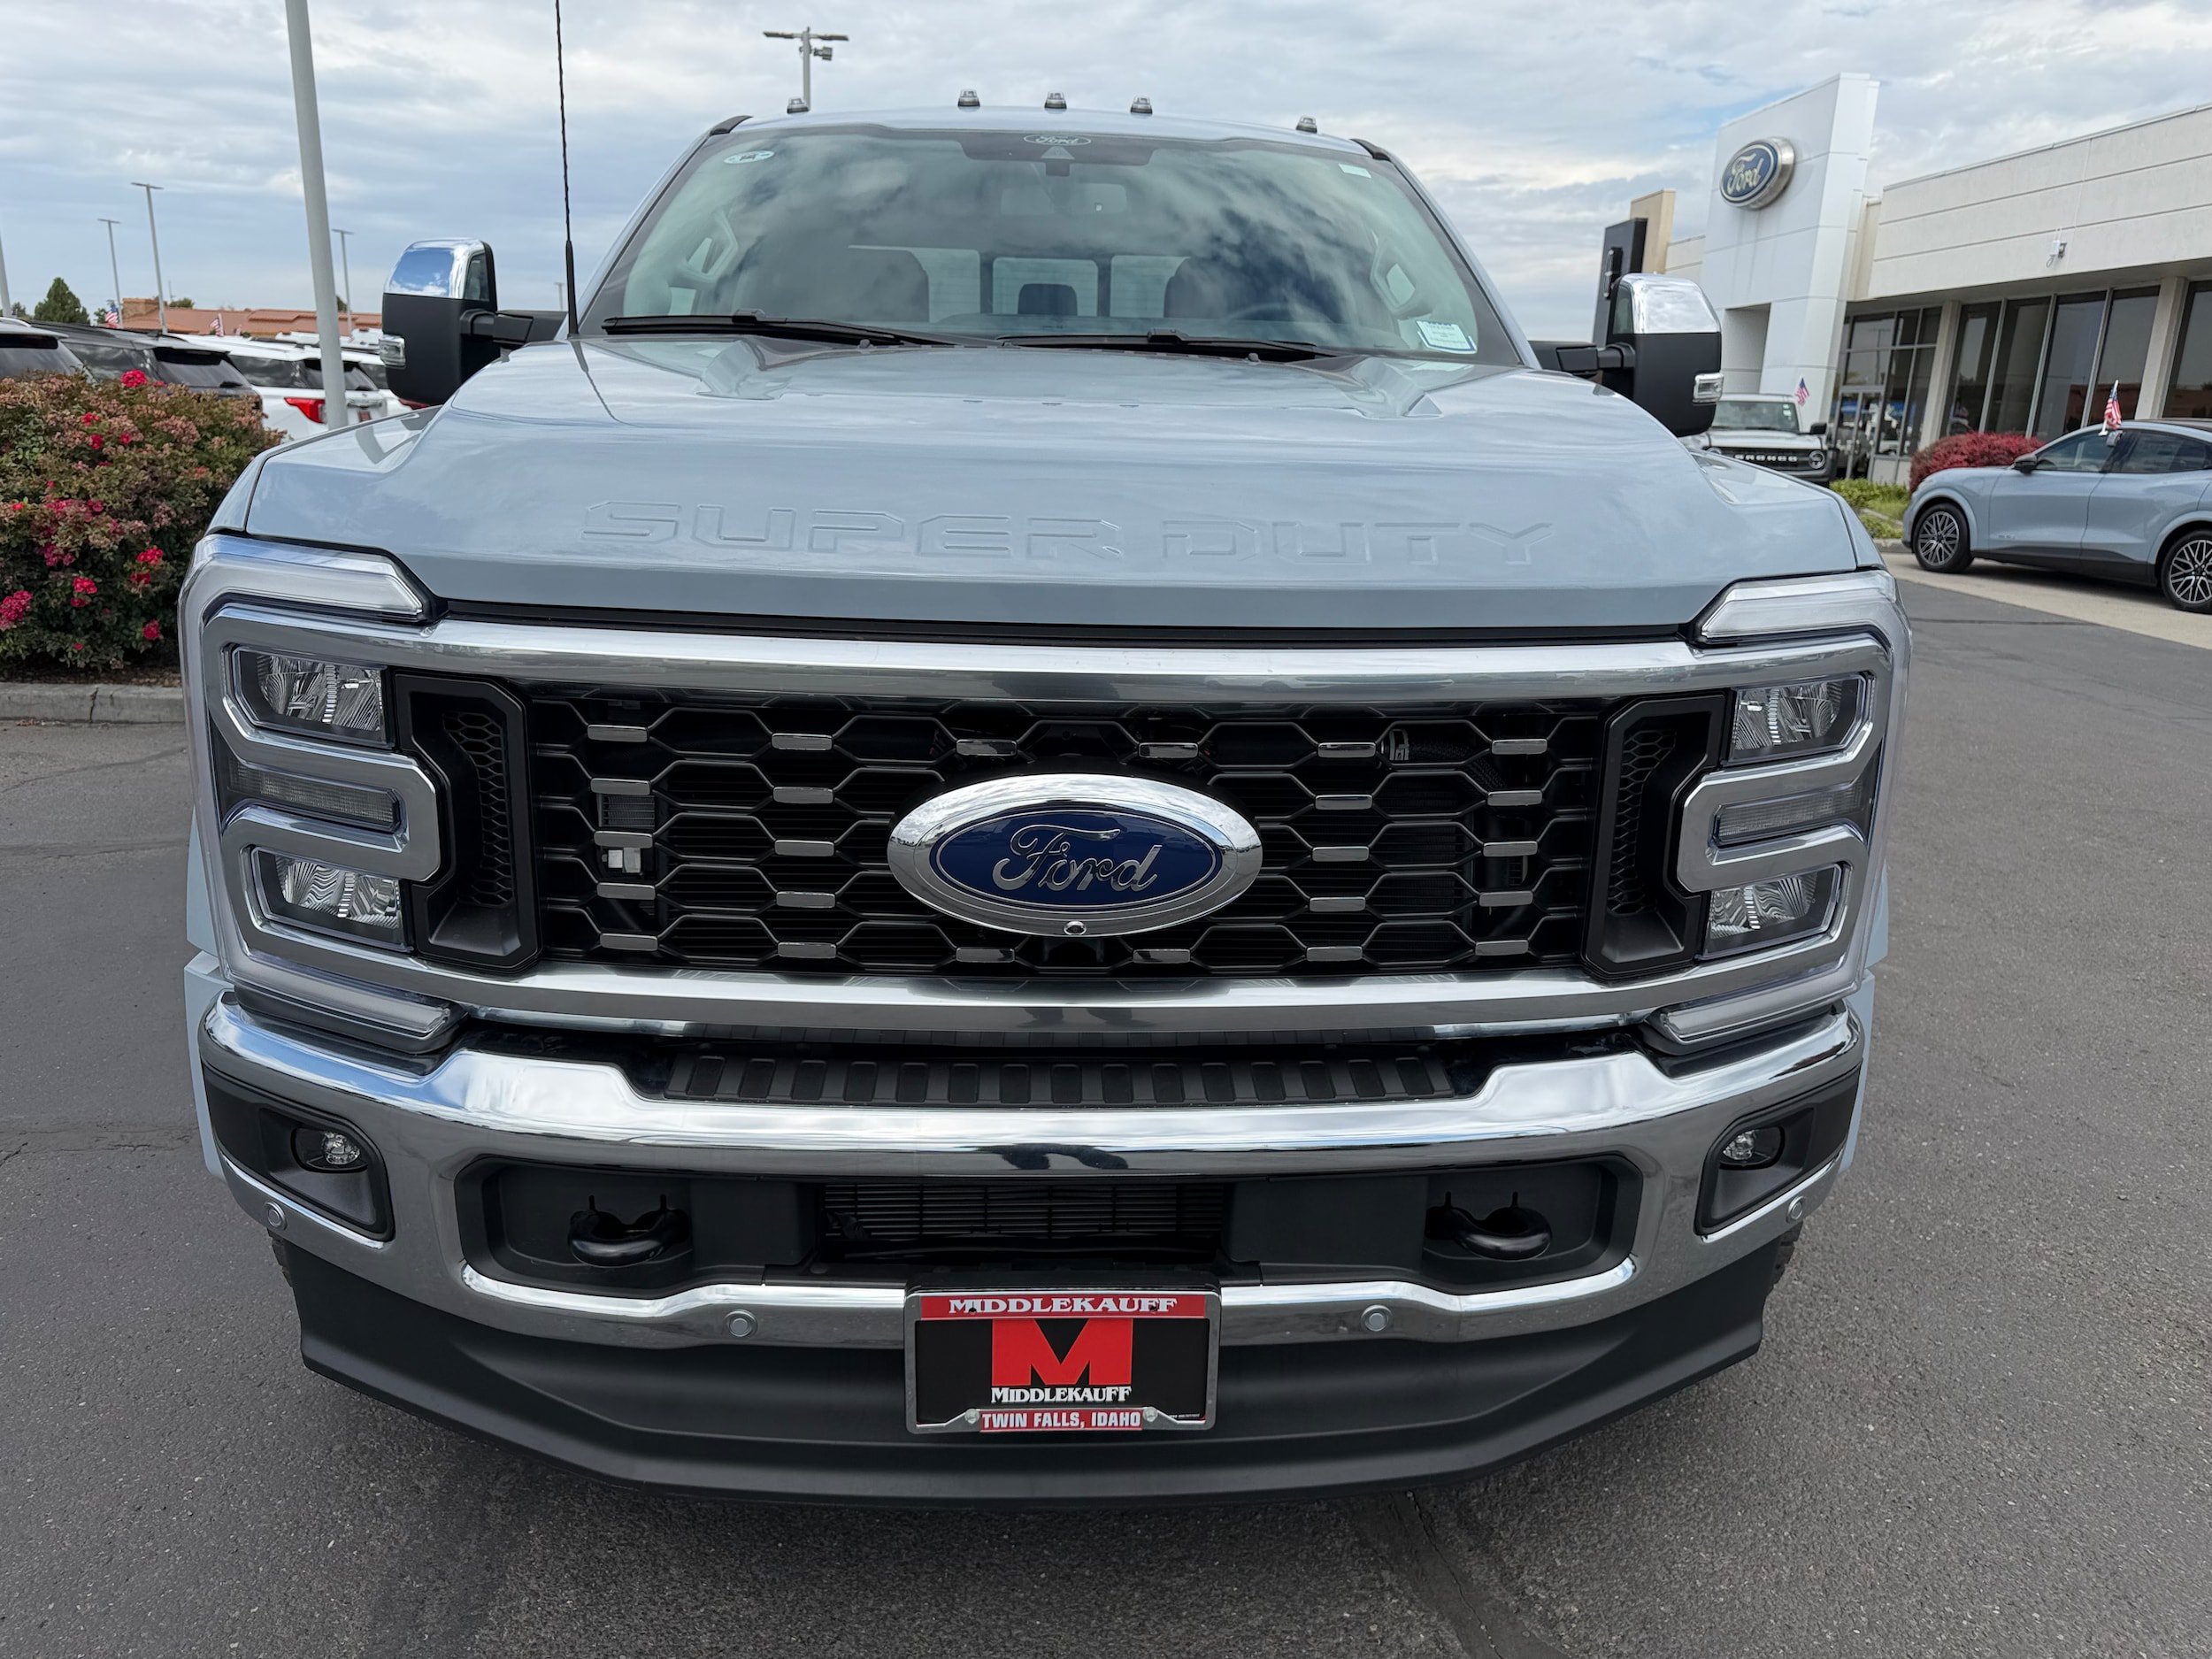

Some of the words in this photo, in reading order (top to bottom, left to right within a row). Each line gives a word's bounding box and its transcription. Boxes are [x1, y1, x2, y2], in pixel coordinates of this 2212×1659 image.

[1035, 135, 1079, 144] Ford
[1726, 152, 1763, 195] Ford
[580, 500, 1124, 559] SUPER
[1161, 519, 1554, 565] DUTY
[992, 823, 1163, 892] Ford
[949, 1297, 1177, 1314] MIDDLEKAUFF
[992, 1318, 1133, 1386] M
[991, 1386, 1132, 1403] MIDDLEKAUFF
[982, 1413, 1029, 1429] TWIN
[1033, 1412, 1085, 1429] FALLS,
[1092, 1412, 1141, 1427] IDAHO
